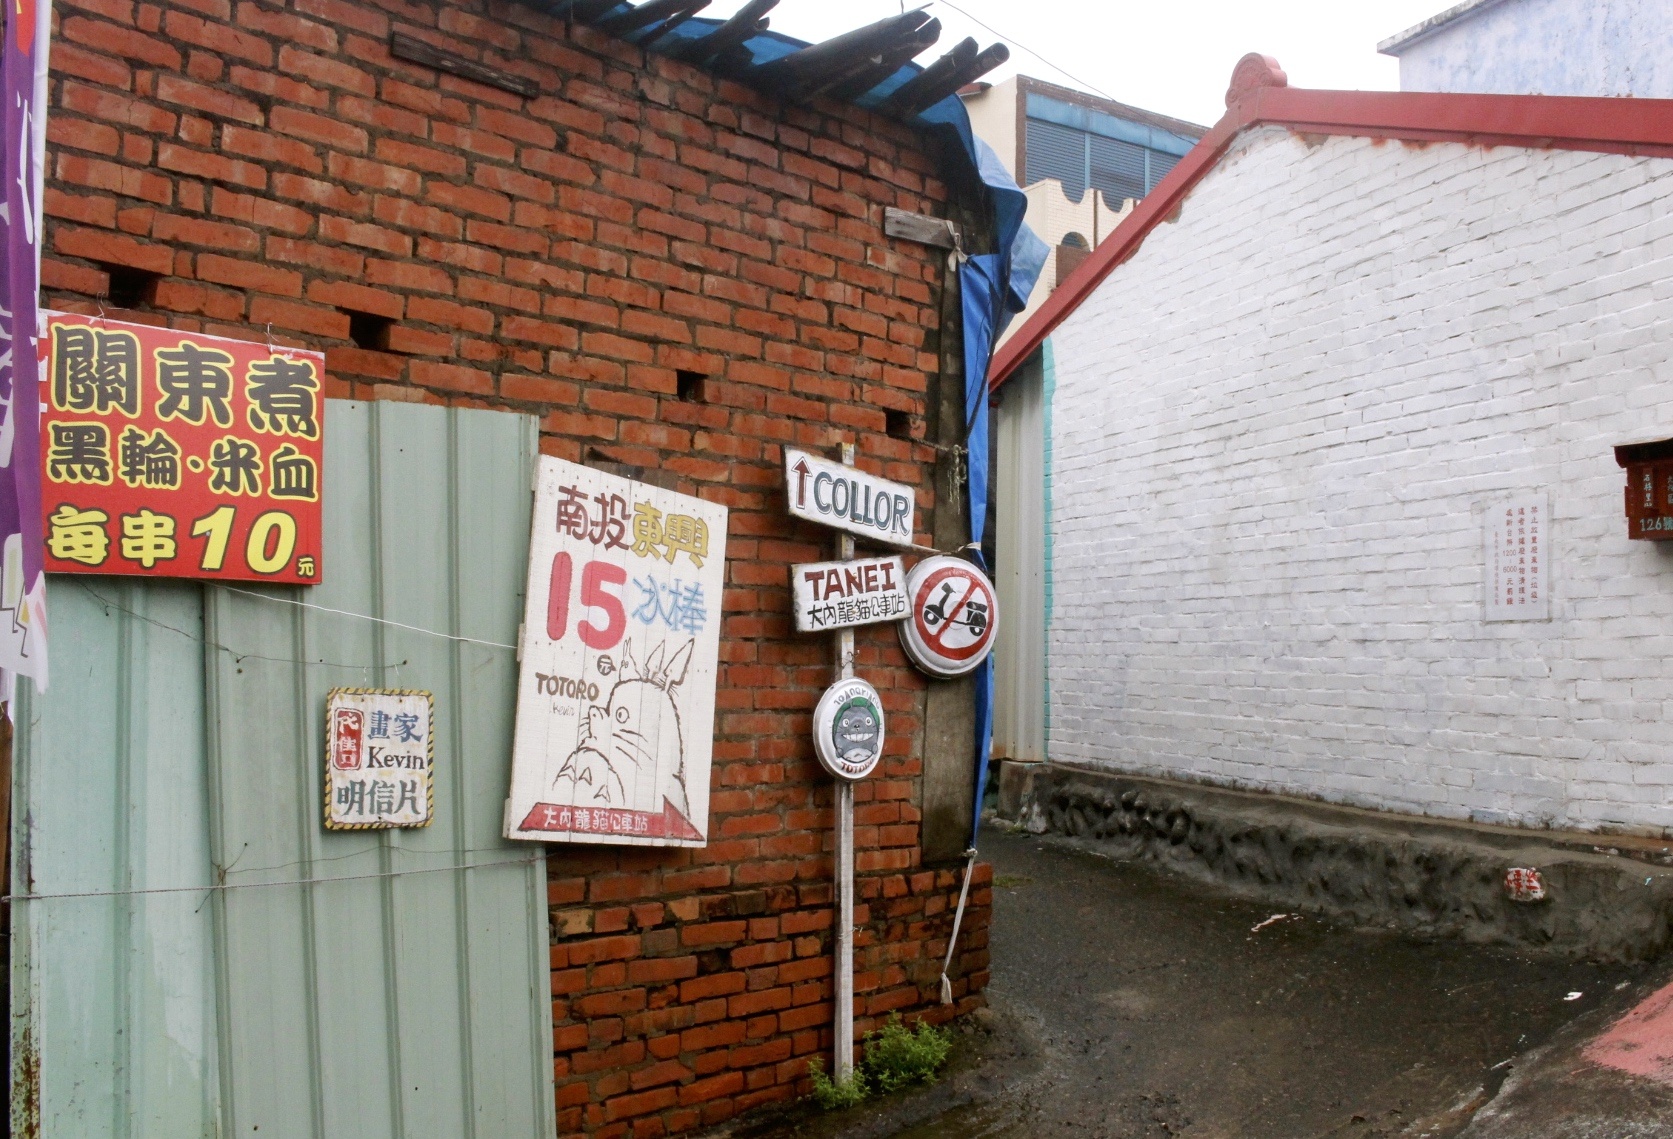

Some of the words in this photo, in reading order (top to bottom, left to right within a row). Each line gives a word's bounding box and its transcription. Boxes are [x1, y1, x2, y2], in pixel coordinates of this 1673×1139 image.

[51, 322, 320, 438] 關東煮
[814, 471, 910, 536] COLLOR
[556, 485, 709, 569] 南投東興
[547, 551, 627, 650] 15
[632, 574, 707, 635] 冰棒
[804, 562, 896, 601] TANEI
[535, 672, 599, 701] TOTORO
[368, 709, 423, 743] 畫家
[366, 746, 425, 770] Kevin
[337, 779, 421, 816] 明信片
